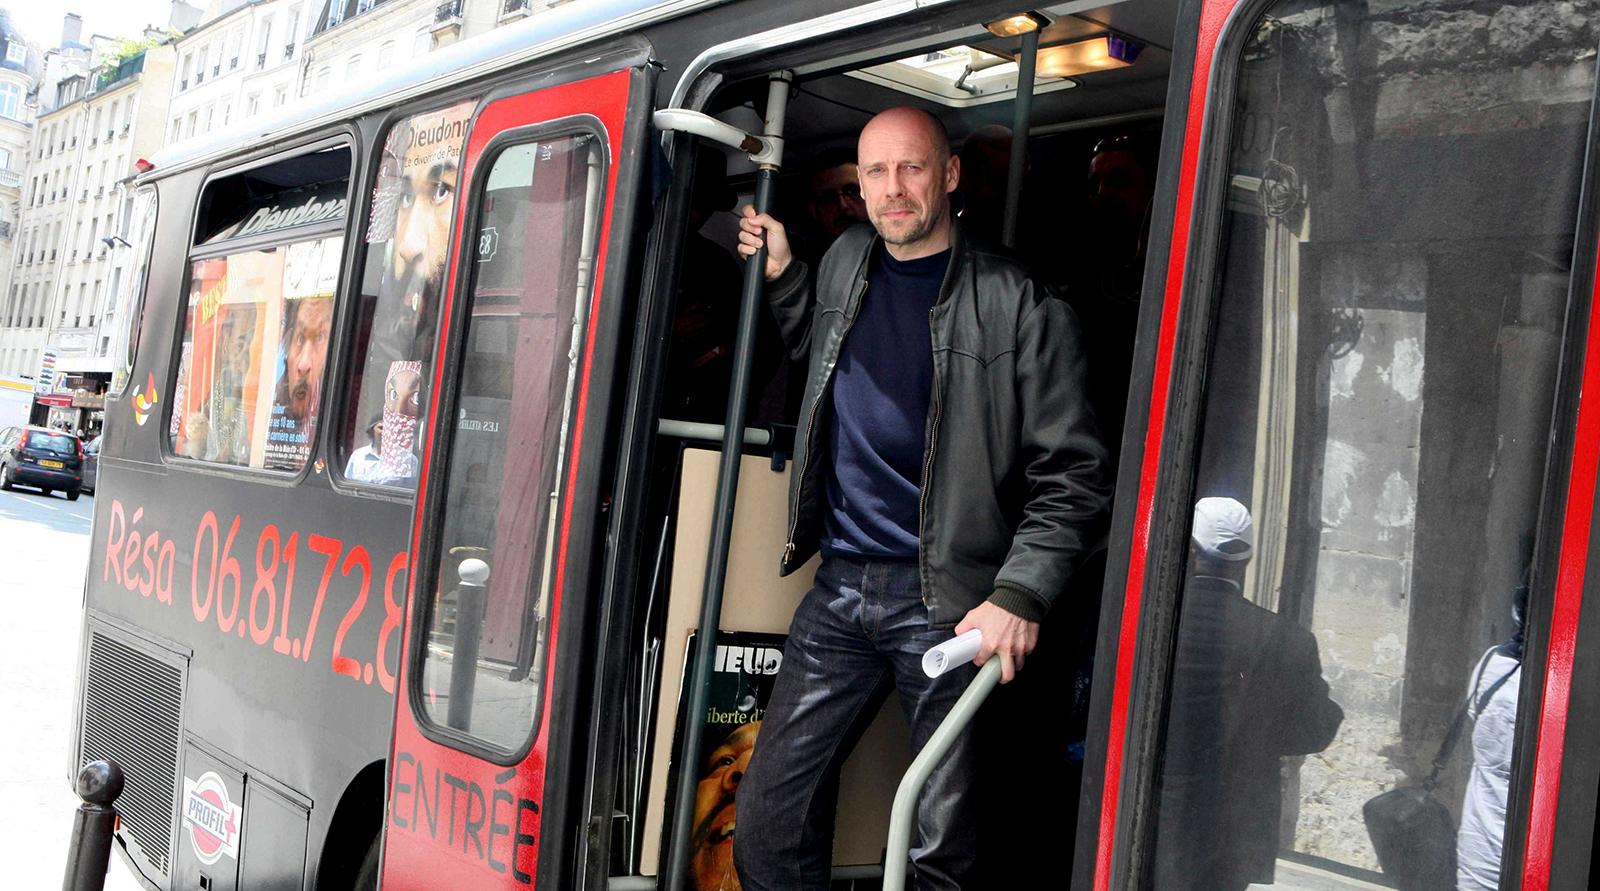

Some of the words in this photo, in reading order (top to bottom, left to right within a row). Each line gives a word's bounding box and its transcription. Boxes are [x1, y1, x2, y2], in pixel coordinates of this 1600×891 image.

[103, 499, 176, 606] Résa
[714, 645, 784, 675] IEUD
[706, 707, 747, 724] iberte
[392, 751, 540, 885] ENTRÉE
